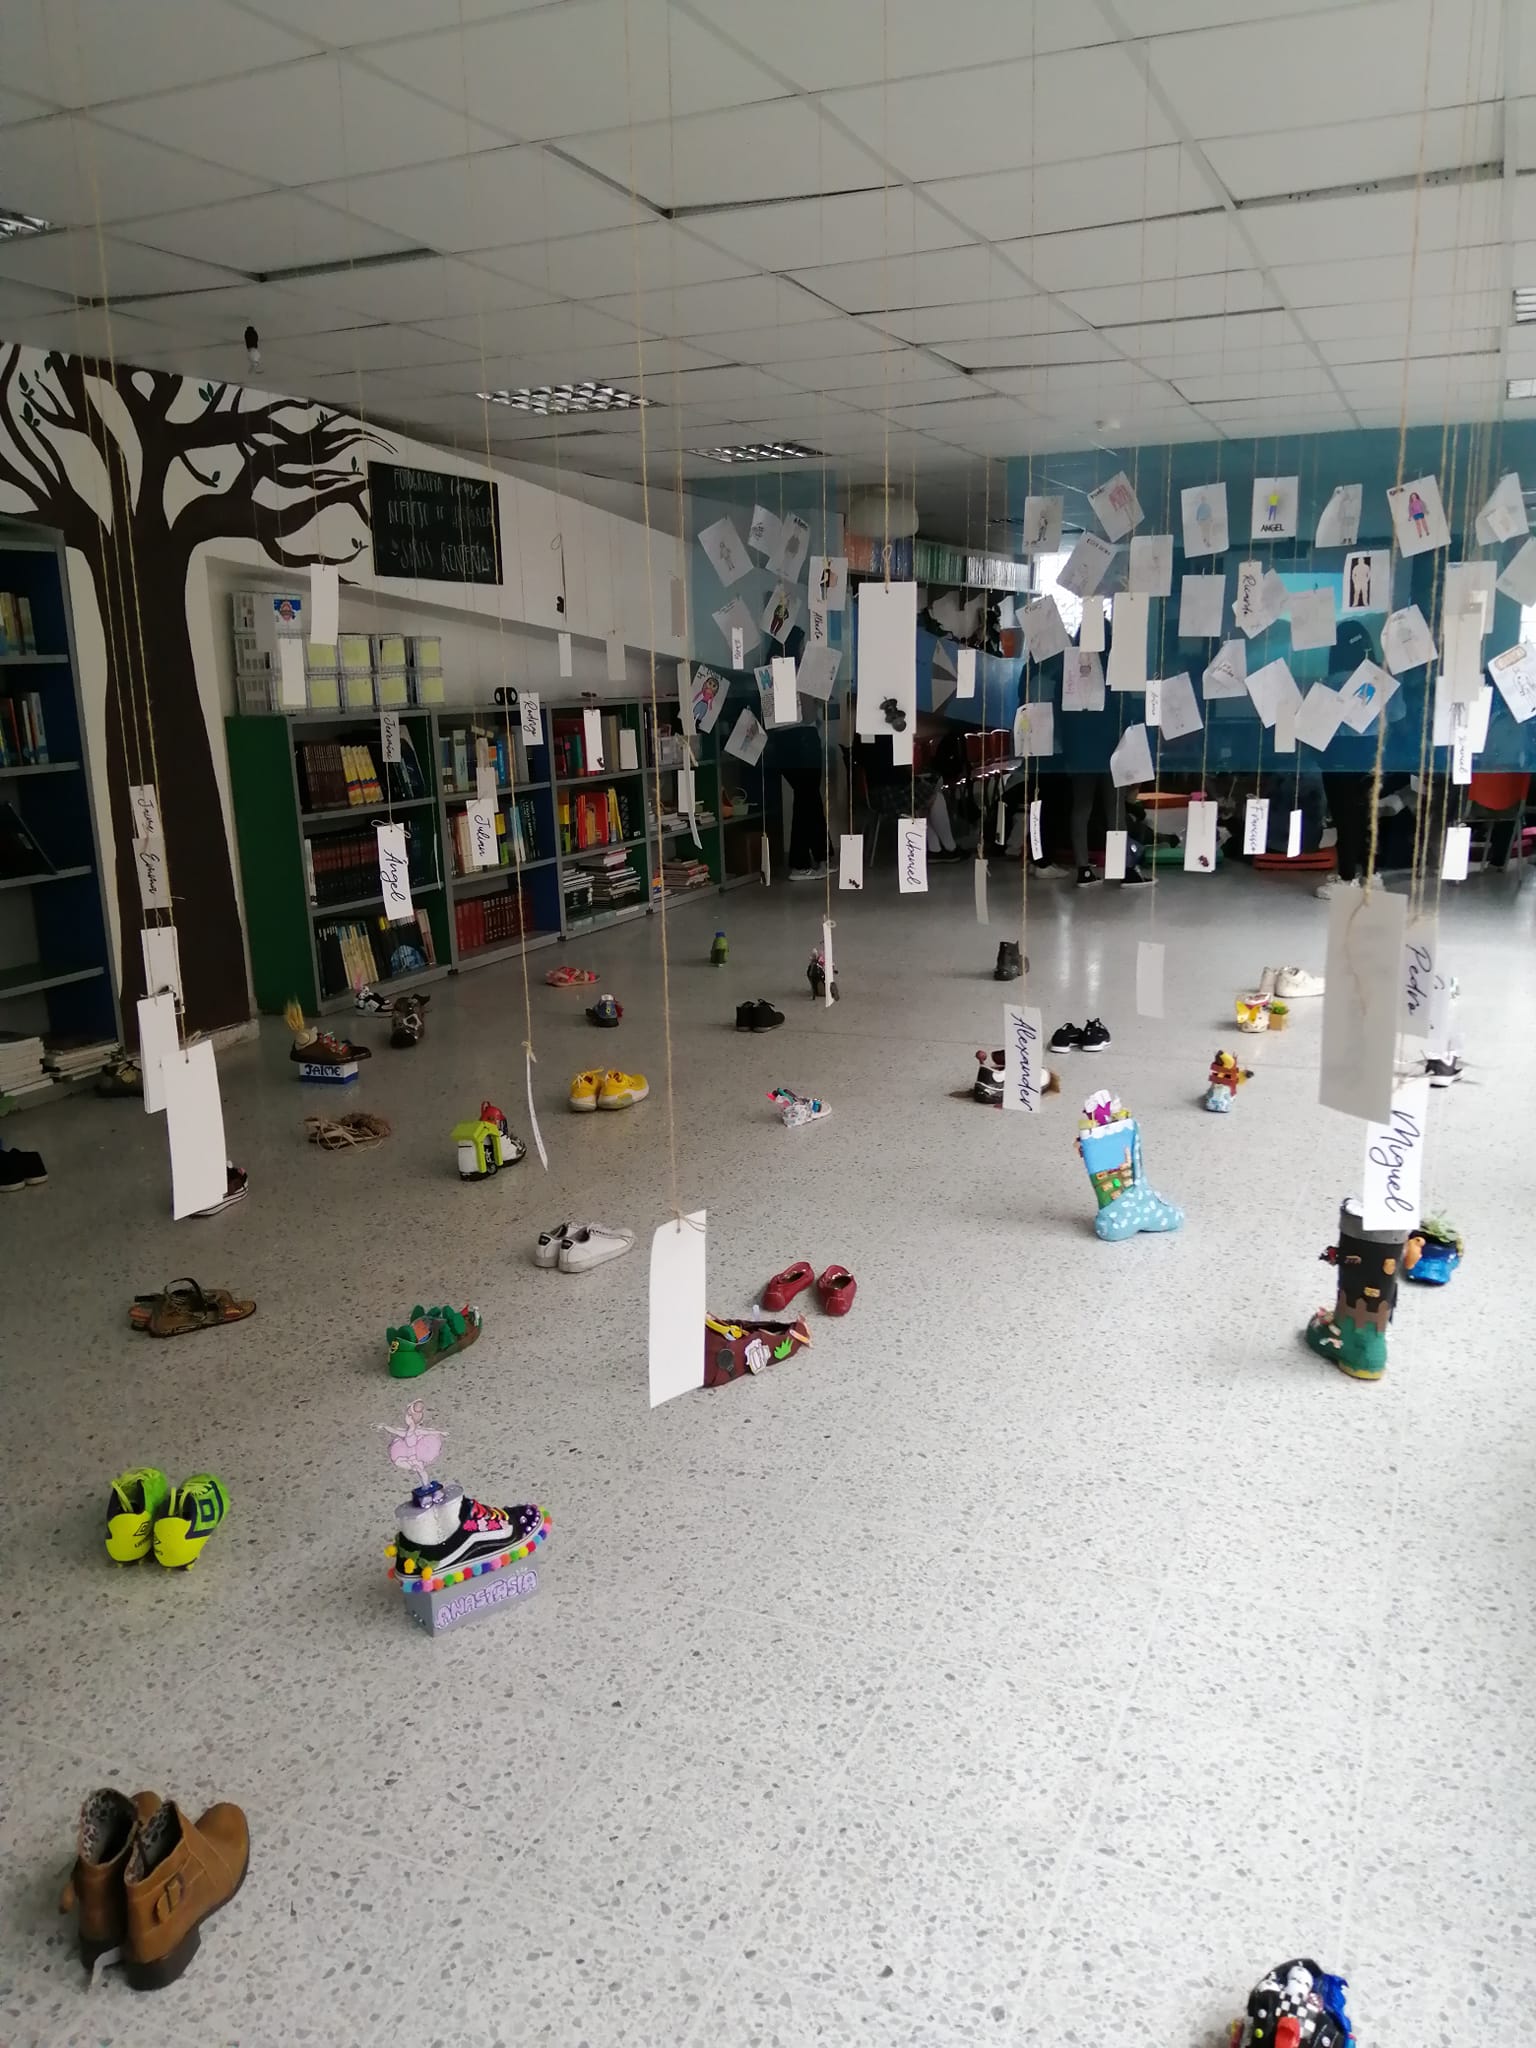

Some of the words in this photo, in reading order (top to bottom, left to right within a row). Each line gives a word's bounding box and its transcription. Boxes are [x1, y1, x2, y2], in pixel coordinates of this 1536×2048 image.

[1260, 523, 1285, 533] ANGEL
[522, 701, 538, 737] Rodrigo
[380, 849, 408, 902] Ángel
[304, 1063, 342, 1077] JAIME
[1010, 1012, 1039, 1112] Alexander
[1368, 1108, 1420, 1213] Miguel
[434, 1570, 538, 1629] ANASTASIA
